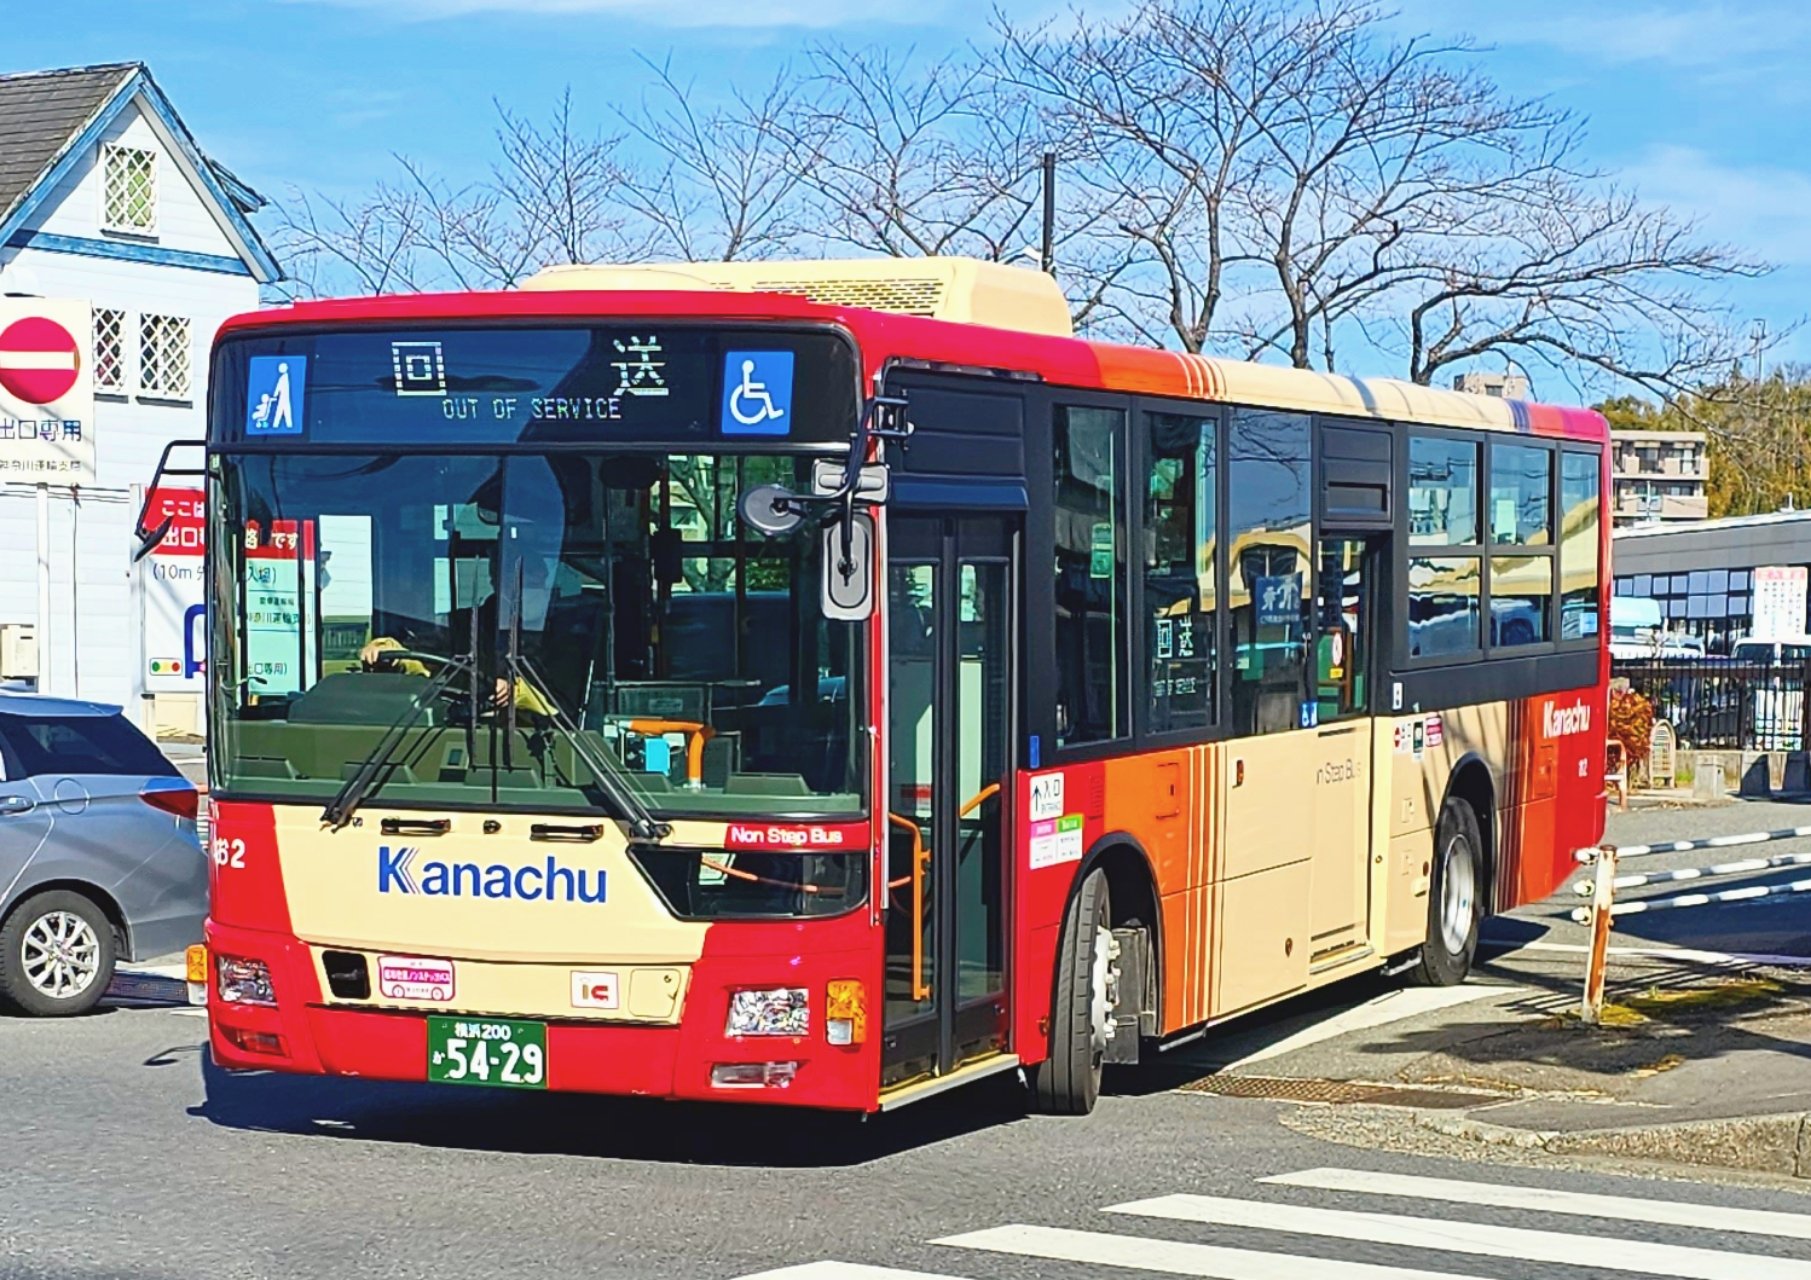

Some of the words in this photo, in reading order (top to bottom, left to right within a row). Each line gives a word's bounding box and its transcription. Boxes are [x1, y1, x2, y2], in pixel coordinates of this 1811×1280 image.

[442, 398, 478, 419] OUT
[493, 398, 517, 419] OF
[531, 398, 622, 419] SERVICE
[1543, 697, 1591, 740] Kanachu
[730, 826, 765, 843] Non
[767, 828, 808, 848] Step
[810, 828, 843, 844] Bus
[378, 845, 608, 904] Kanachu
[446, 1037, 543, 1084] 54-29
